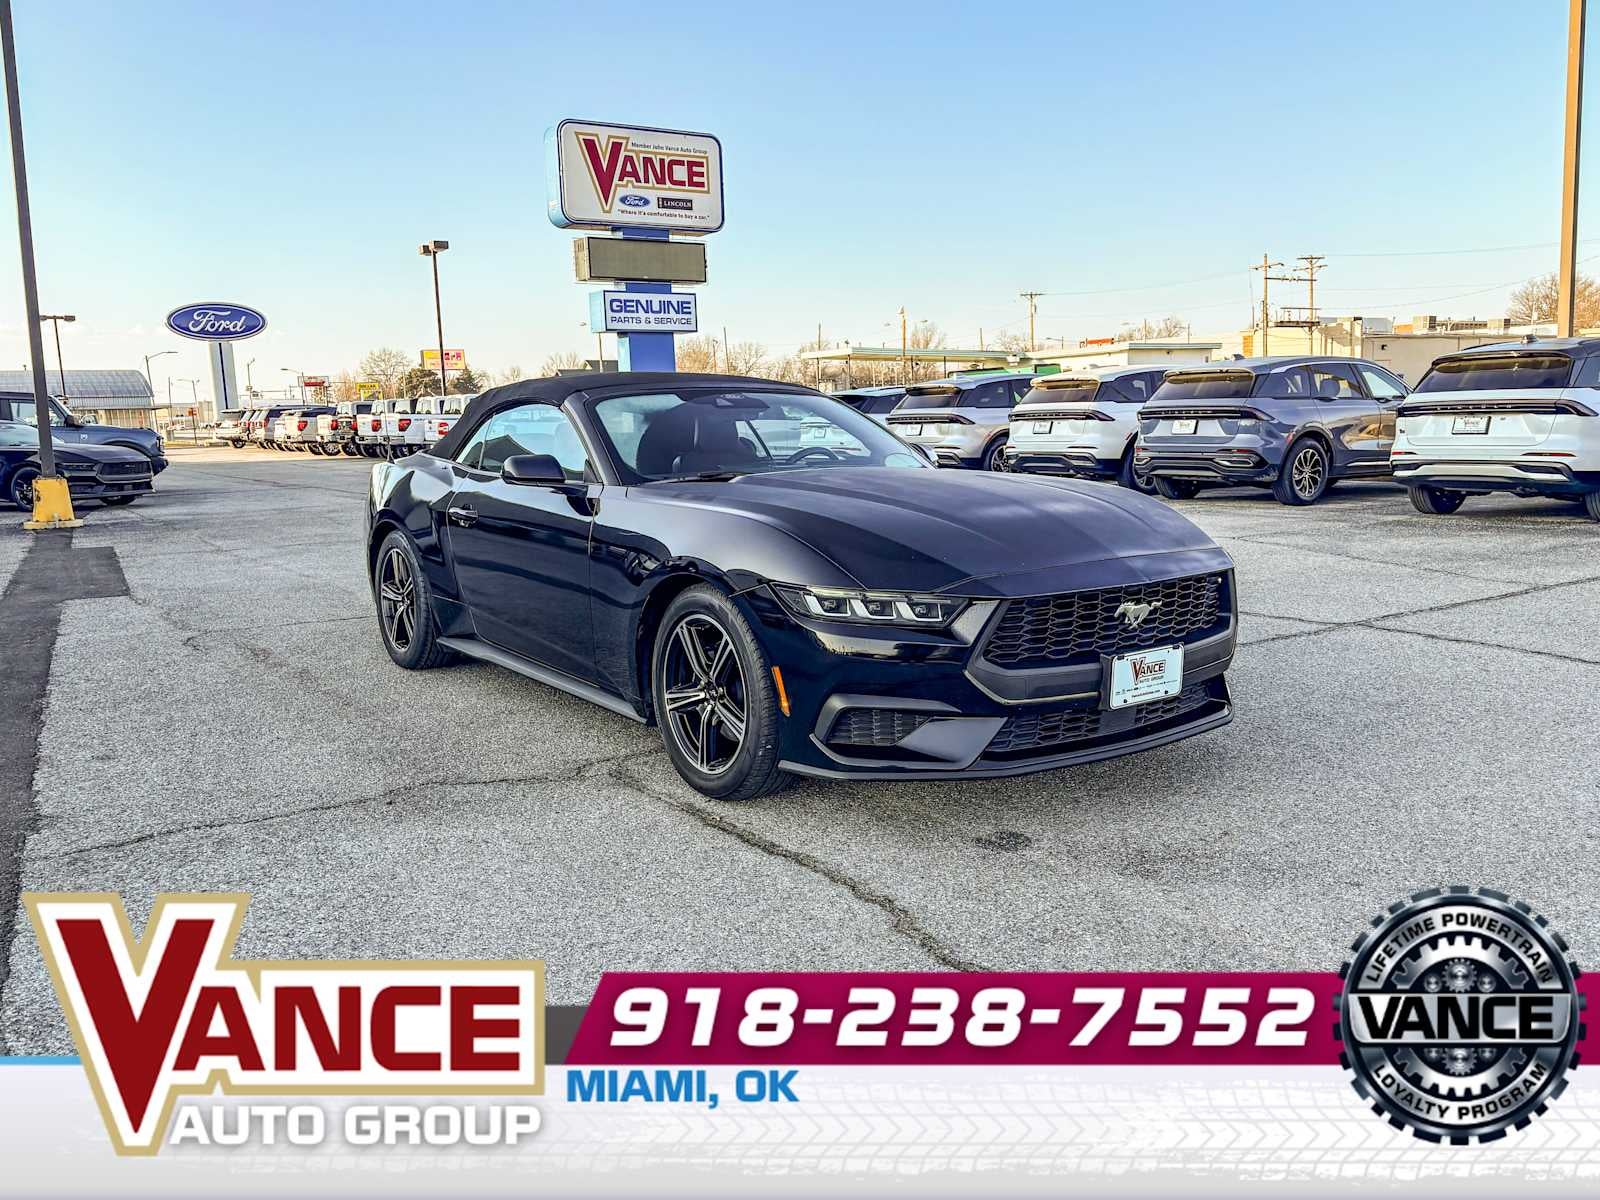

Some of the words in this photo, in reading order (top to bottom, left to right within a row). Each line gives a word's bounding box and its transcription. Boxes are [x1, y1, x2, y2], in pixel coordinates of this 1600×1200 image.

[581, 138, 705, 207] VANCE
[663, 200, 692, 208] LINCOLN
[609, 298, 692, 315] GENUINE
[188, 309, 246, 332] Ford
[610, 316, 642, 324] PARTS
[654, 317, 692, 325] SERVICE
[1132, 659, 1165, 682] VANCE
